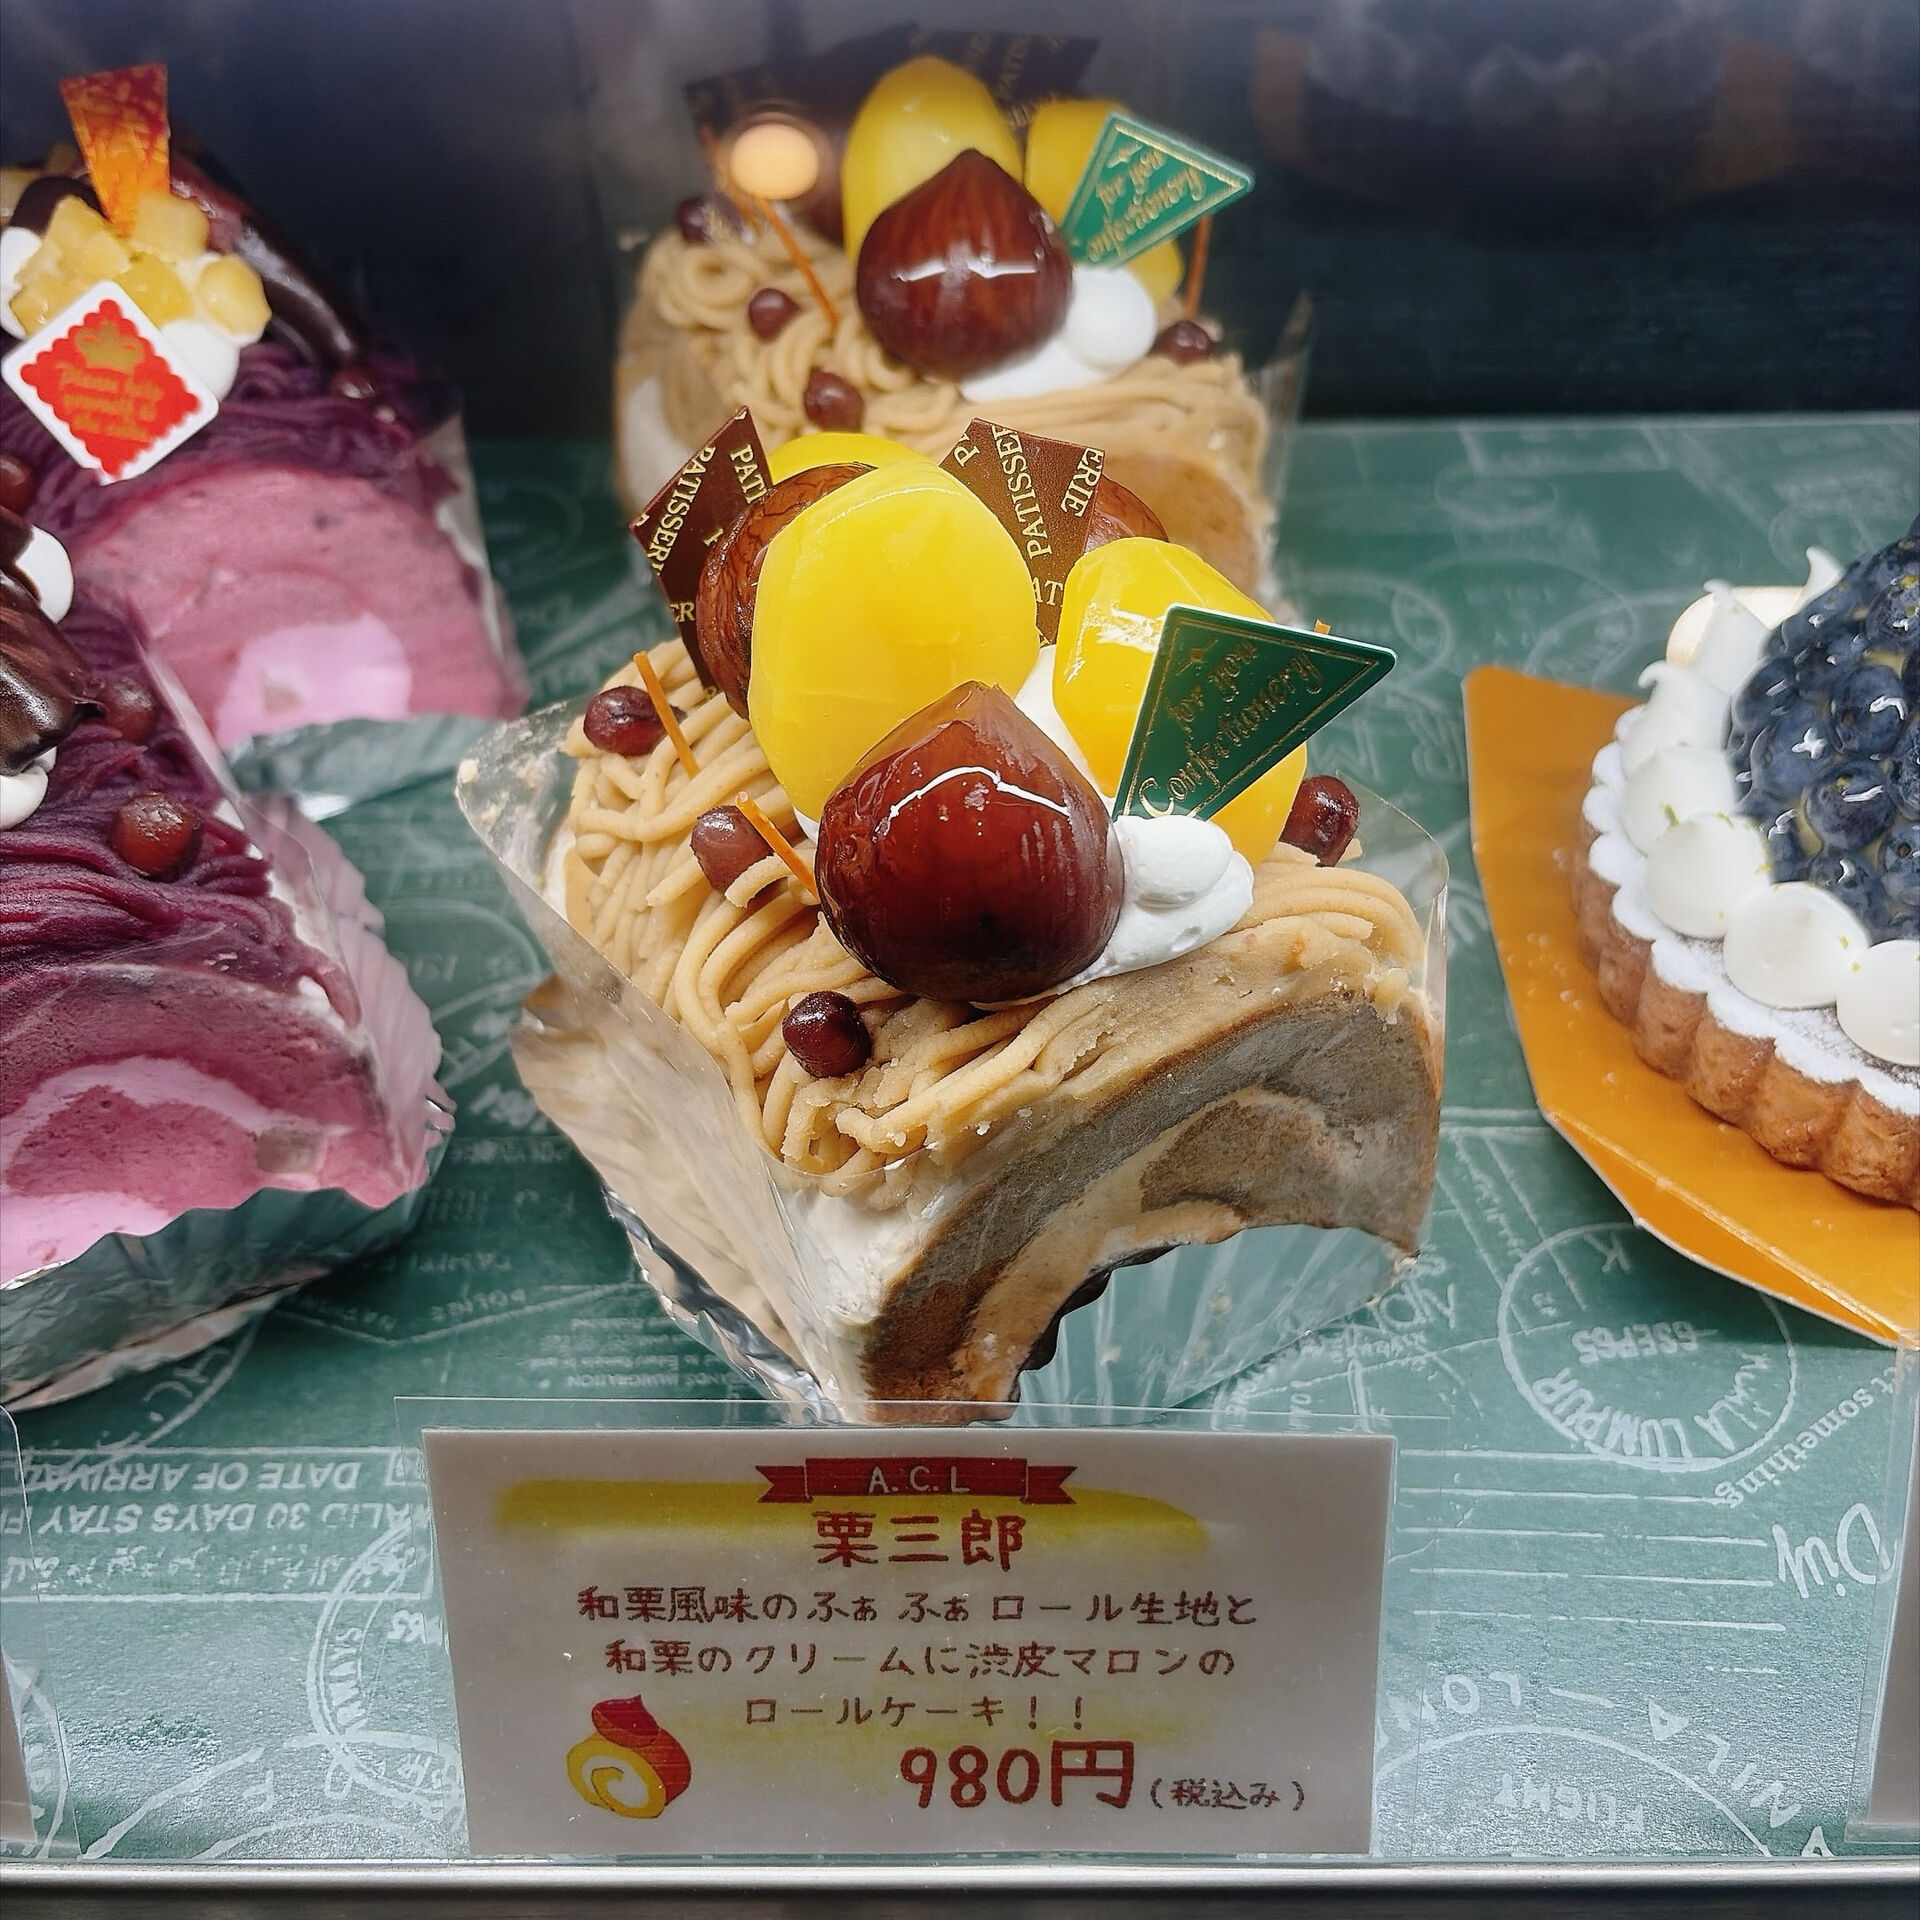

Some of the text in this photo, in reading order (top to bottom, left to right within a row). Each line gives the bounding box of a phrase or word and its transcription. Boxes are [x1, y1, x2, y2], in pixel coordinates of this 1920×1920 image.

[1138, 650, 1325, 818] Confectionery
[1712, 1386, 1876, 1510] something
[196, 1462, 250, 1492] OF
[257, 1460, 361, 1491] DATE
[37, 1503, 145, 1534] STAY
[152, 1502, 257, 1533] DAYS
[265, 1501, 312, 1531] 30
[812, 1509, 1028, 1572] 栗三郎
[606, 1638, 1236, 1679] 和栗のクリームに渋皮マロンの
[900, 1739, 1136, 1810] 980円
